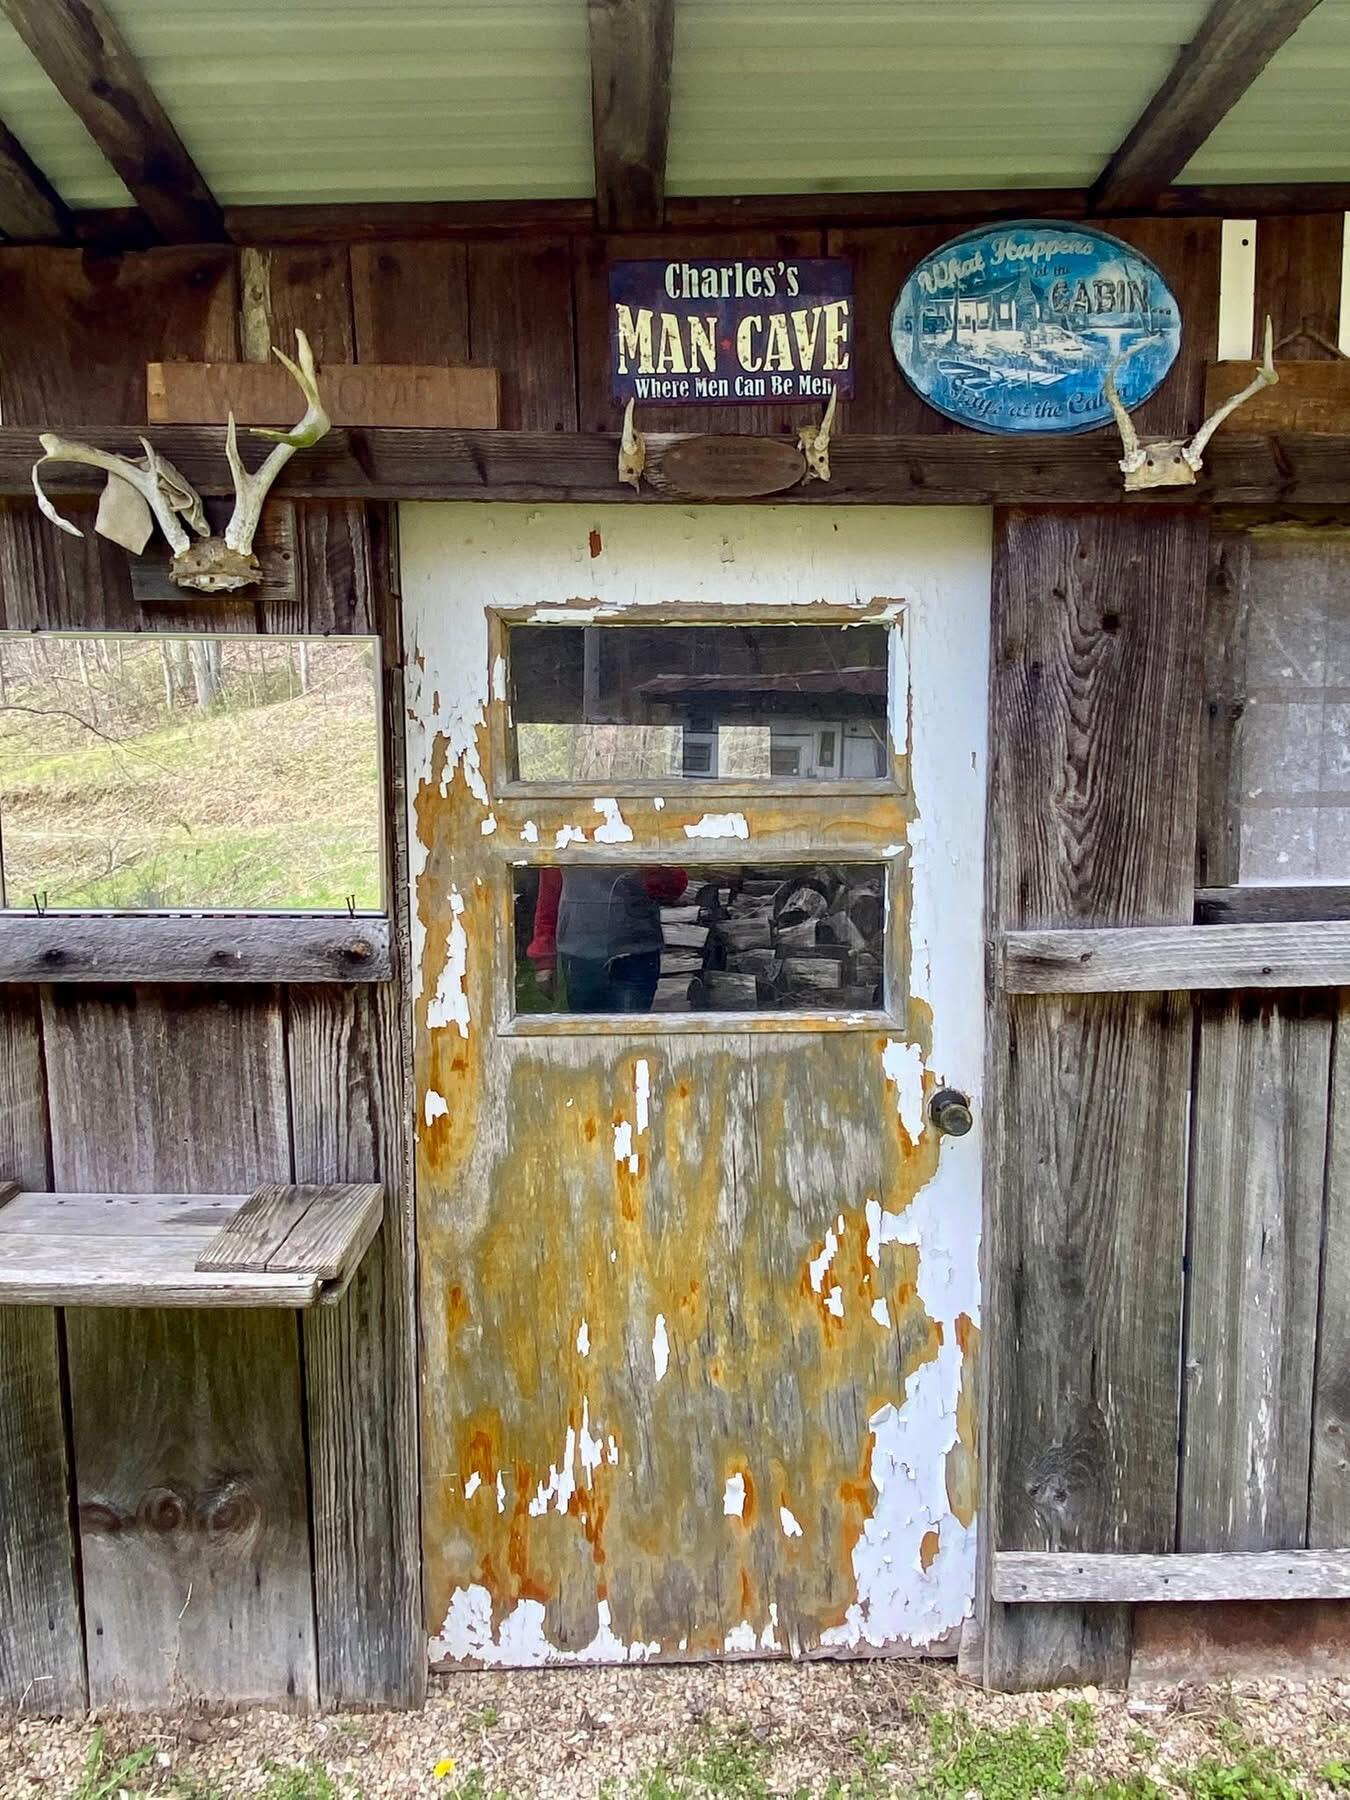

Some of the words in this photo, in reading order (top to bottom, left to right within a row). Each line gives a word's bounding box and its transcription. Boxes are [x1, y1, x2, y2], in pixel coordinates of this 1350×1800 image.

[664, 261, 800, 299] Charles's
[917, 251, 986, 294] What
[990, 237, 1095, 265] Happens
[615, 303, 718, 375] MAN
[736, 299, 850, 373] CAVE
[634, 377, 690, 399] Where
[695, 377, 729, 398] Men
[735, 375, 765, 397] Can
[771, 375, 793, 396] Be
[799, 374, 832, 396] Men
[1008, 404, 1031, 418] at
[1034, 400, 1062, 419] the
[1067, 386, 1128, 414] Cabn
